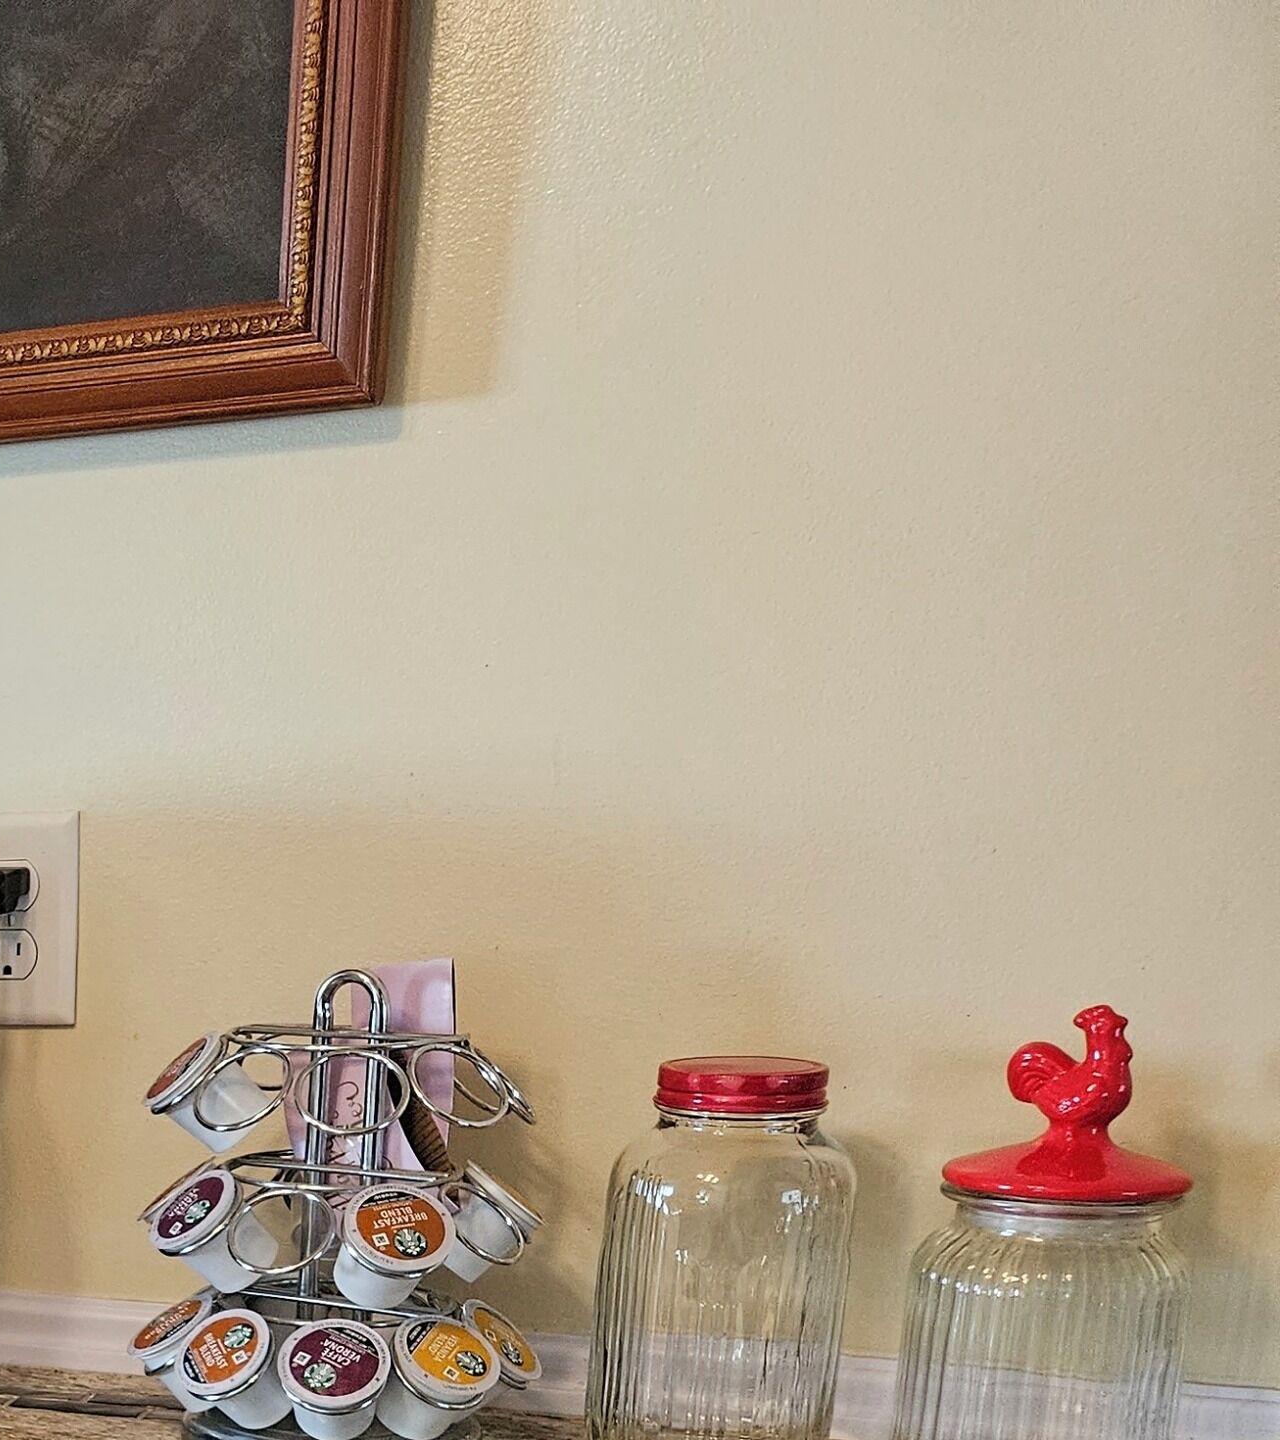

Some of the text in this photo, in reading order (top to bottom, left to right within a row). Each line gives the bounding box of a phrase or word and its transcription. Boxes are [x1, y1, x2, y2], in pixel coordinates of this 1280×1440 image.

[373, 1212, 428, 1229] BREAKFAST
[380, 1206, 413, 1218] BLEND
[323, 1338, 361, 1363] VERONA
